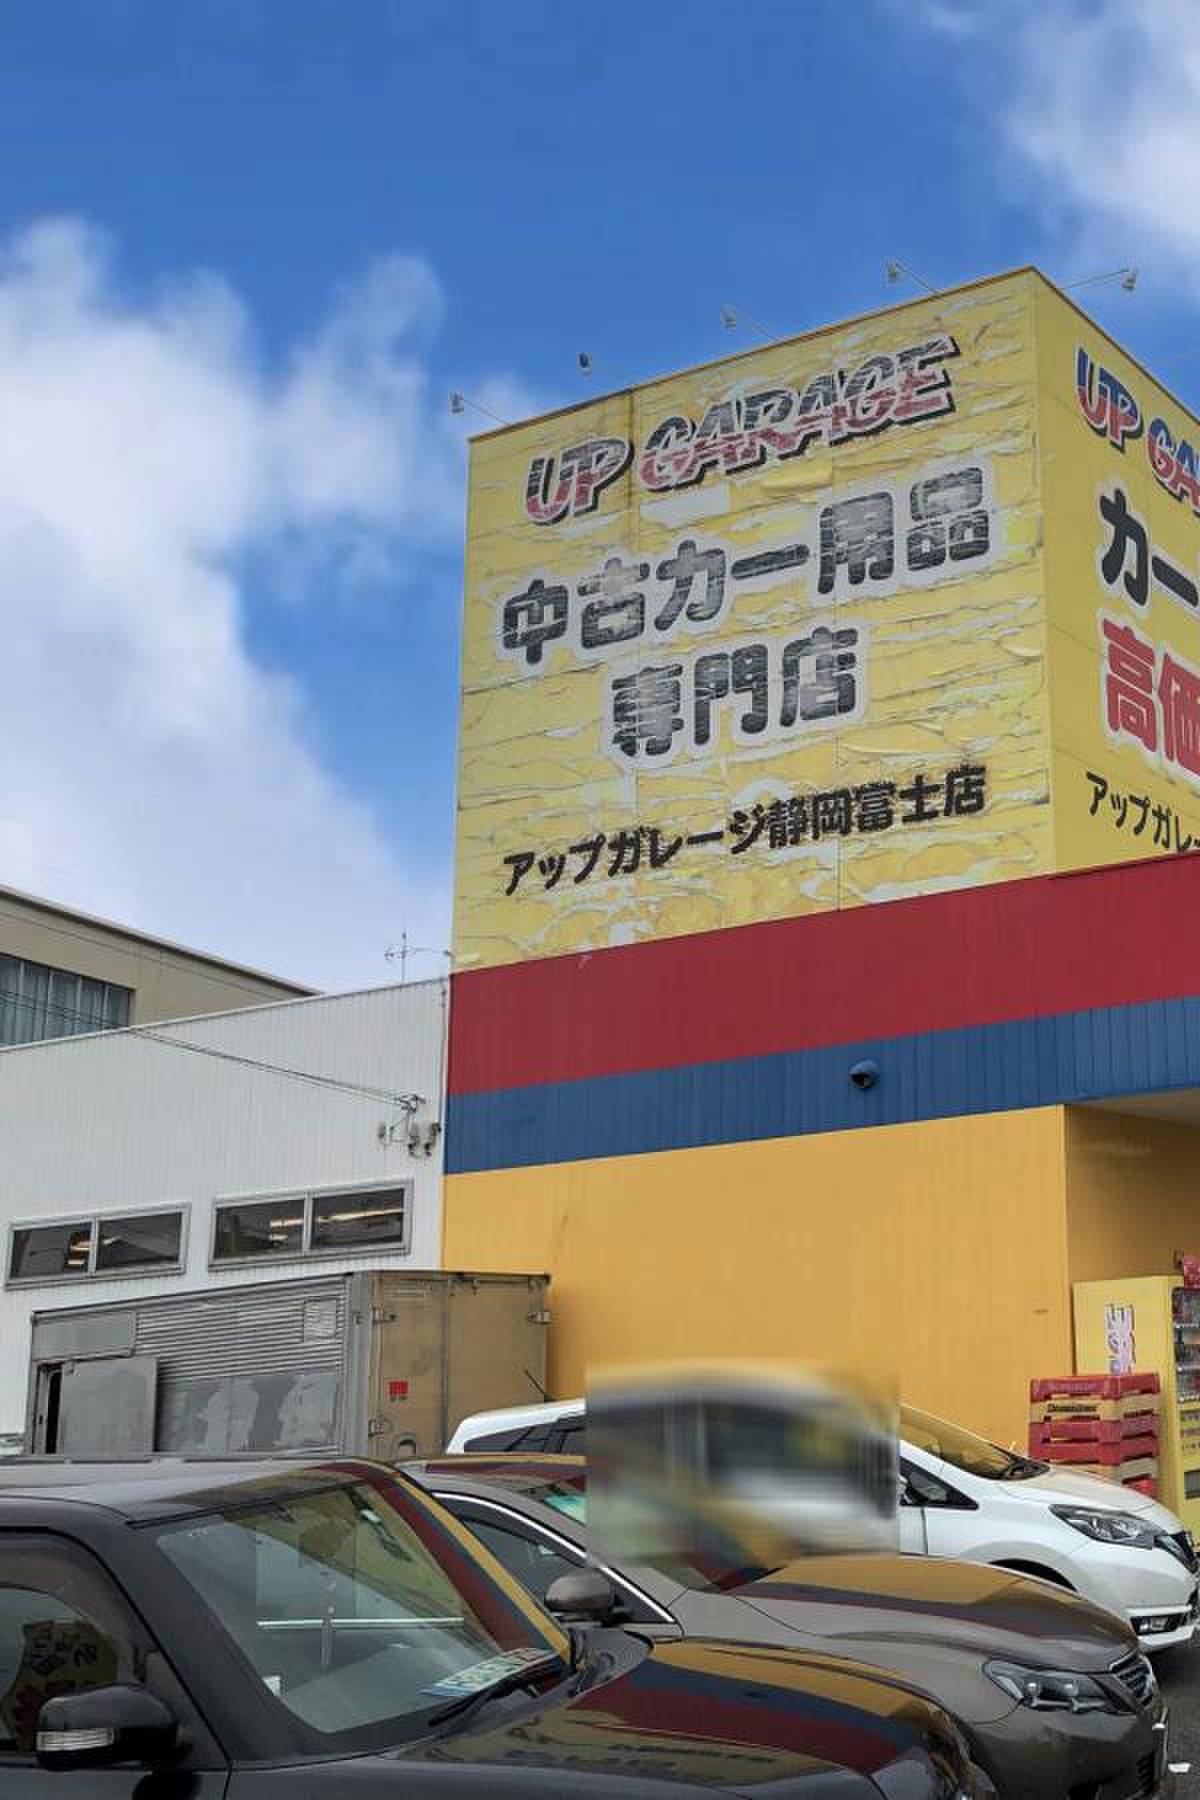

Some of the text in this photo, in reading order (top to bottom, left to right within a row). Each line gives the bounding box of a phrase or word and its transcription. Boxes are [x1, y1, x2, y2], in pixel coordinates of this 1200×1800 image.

[525, 334, 961, 525] UP GARAGE
[1075, 348, 1144, 453] UP
[502, 466, 991, 664] 中古カー用品
[611, 627, 859, 757] 専門店
[503, 764, 987, 896] アップガレージ静岡富士店
